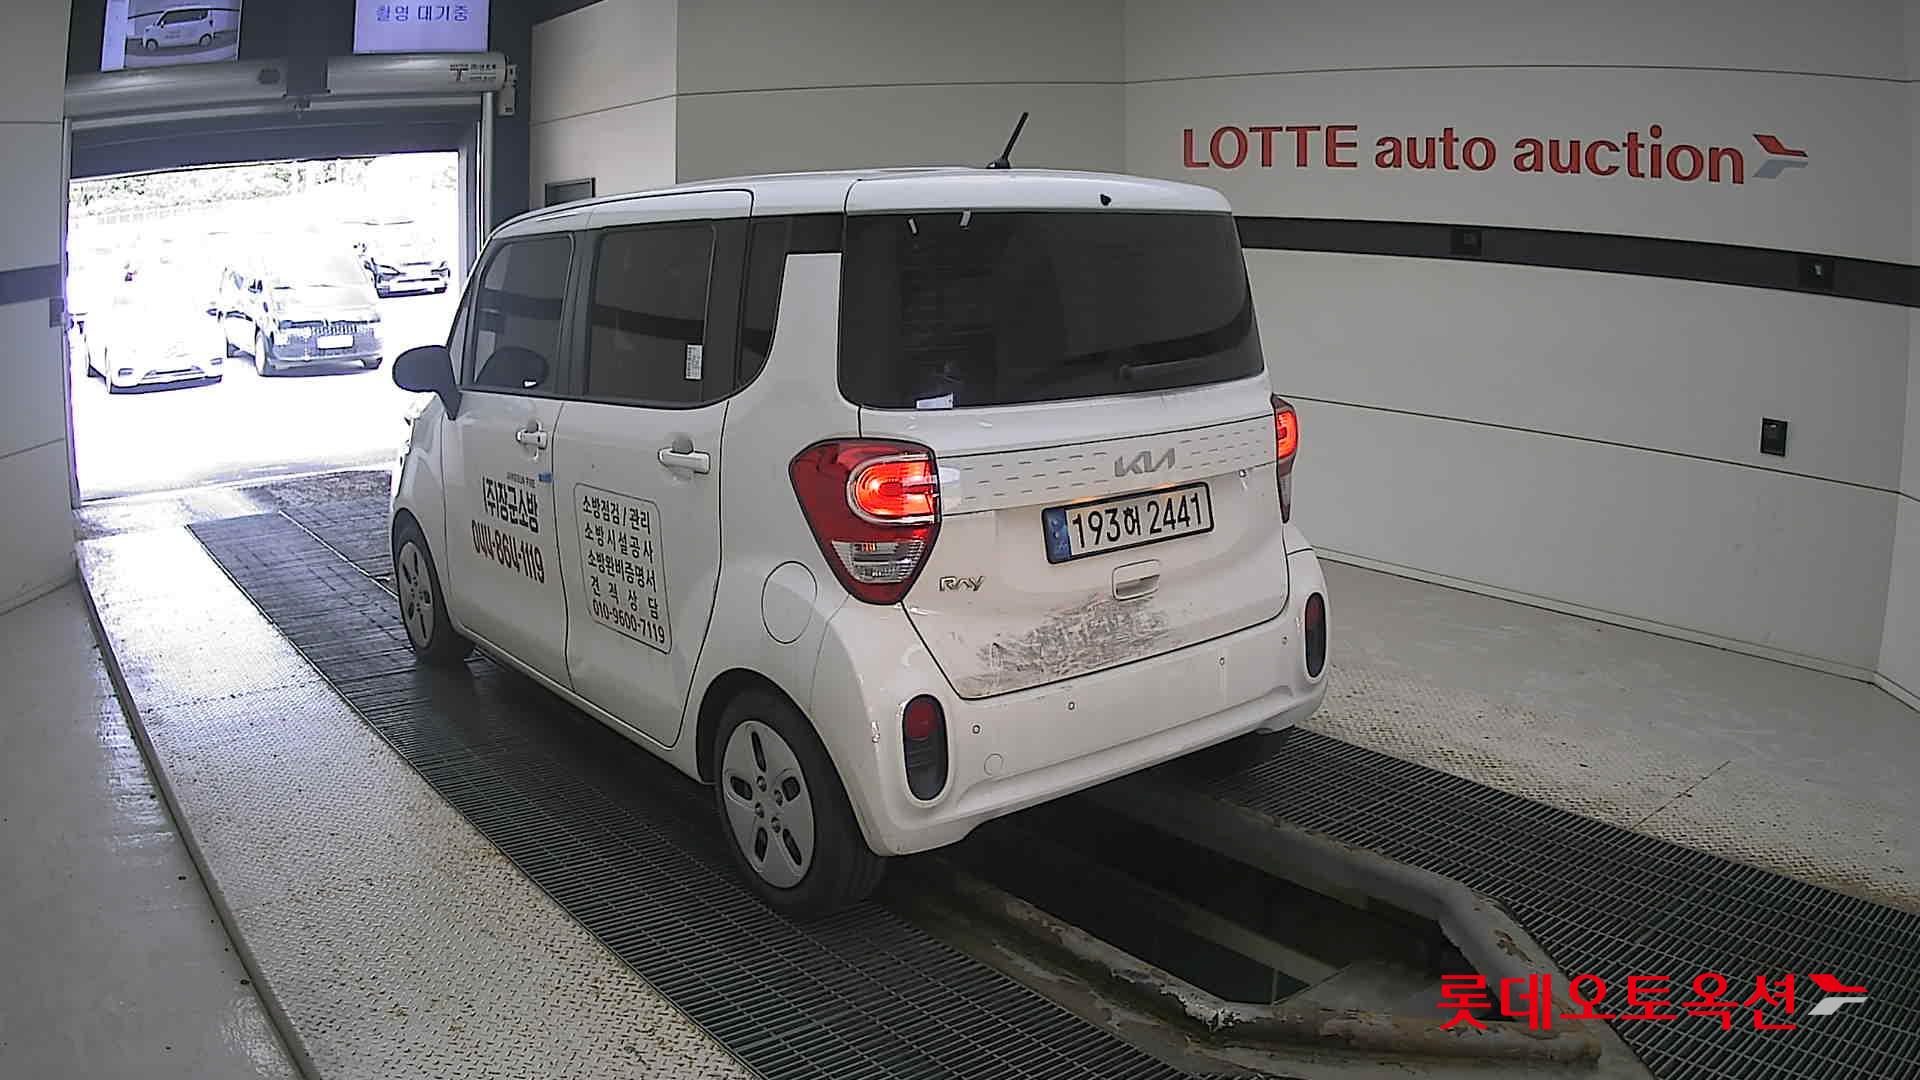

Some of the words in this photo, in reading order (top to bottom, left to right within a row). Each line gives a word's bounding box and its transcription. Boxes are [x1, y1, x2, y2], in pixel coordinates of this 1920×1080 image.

[417, 5, 469, 22] 대기중
[1183, 124, 1358, 170] LOTTE
[1375, 127, 1496, 171] auto
[1513, 124, 1745, 185] auction
[1114, 448, 1176, 478] KIA
[1072, 505, 1141, 549] 193허
[1149, 492, 1205, 534] 2441
[472, 519, 545, 584] 044-864-1119
[588, 549, 657, 593] 소방완비증명서
[939, 575, 985, 592] RAY
[593, 599, 666, 644] 010-9600-7119
